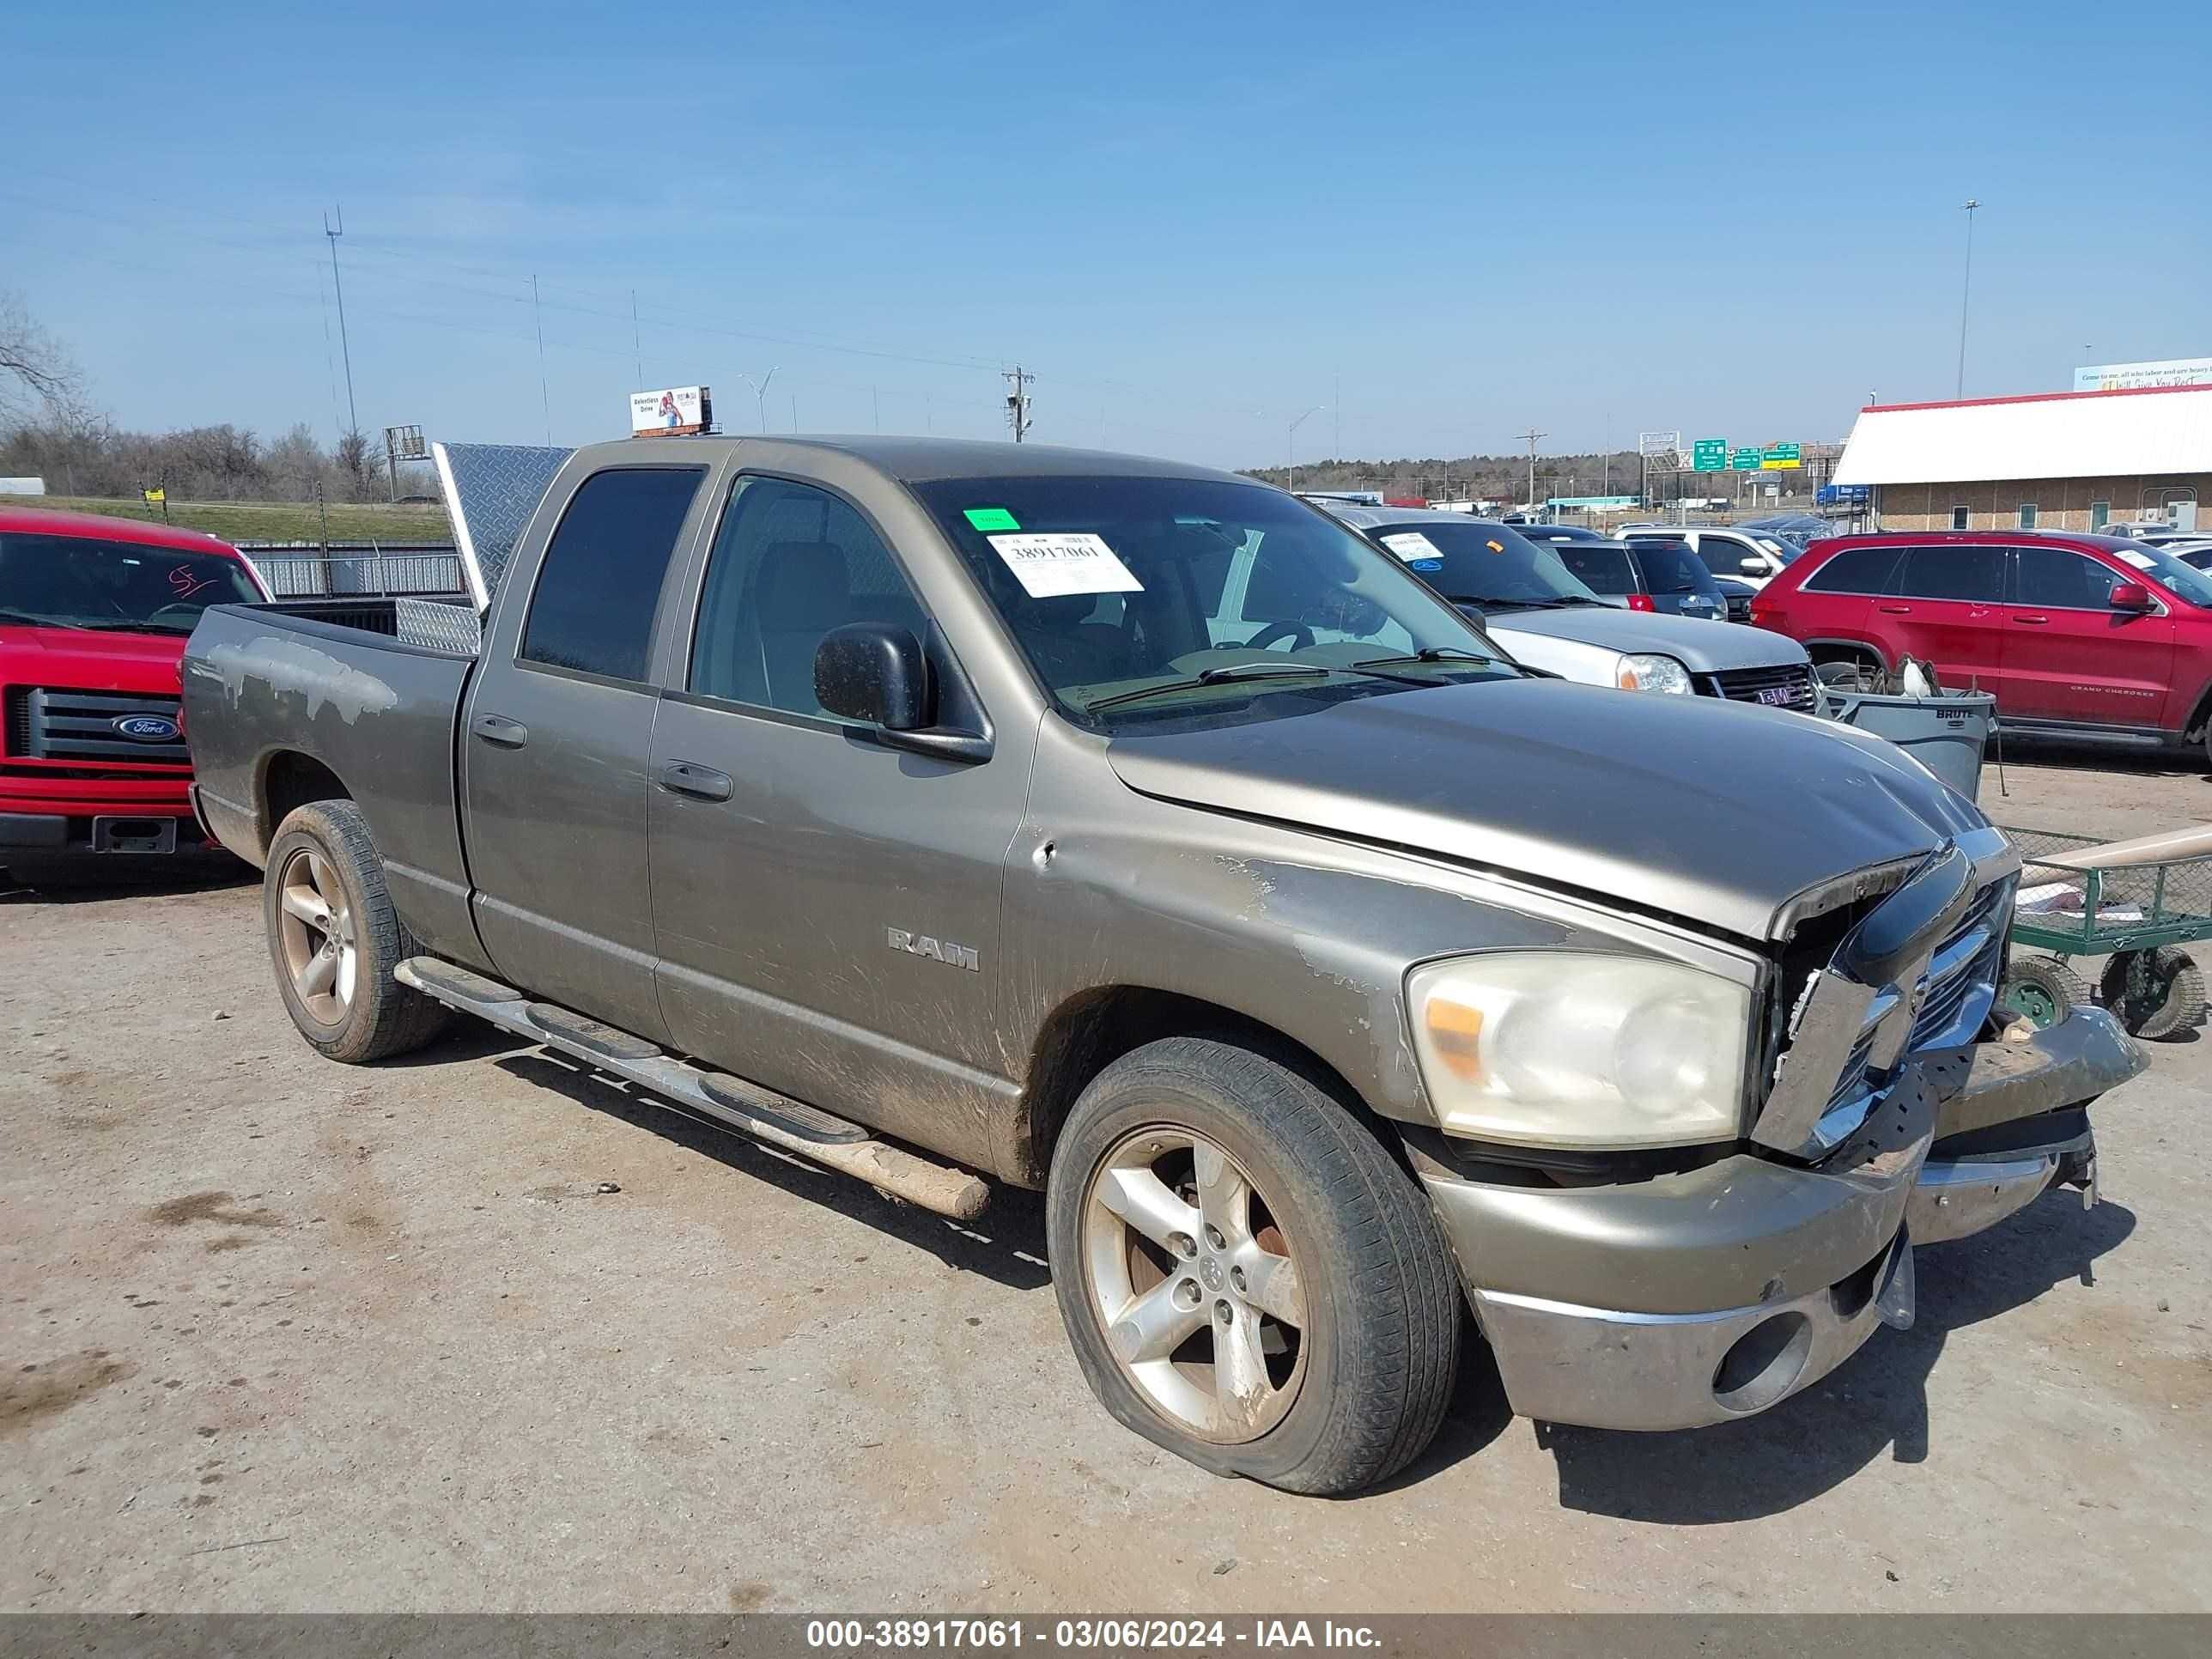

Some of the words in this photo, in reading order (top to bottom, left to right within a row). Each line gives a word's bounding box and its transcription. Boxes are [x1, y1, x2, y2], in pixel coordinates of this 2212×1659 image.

[1010, 546, 1100, 560] 38917061
[1759, 687, 1802, 705] GMC
[2104, 688, 2155, 697] CHEROKEE
[1936, 709, 1974, 719] BRUTE
[133, 720, 165, 734] Ford
[887, 927, 981, 973] RAM
